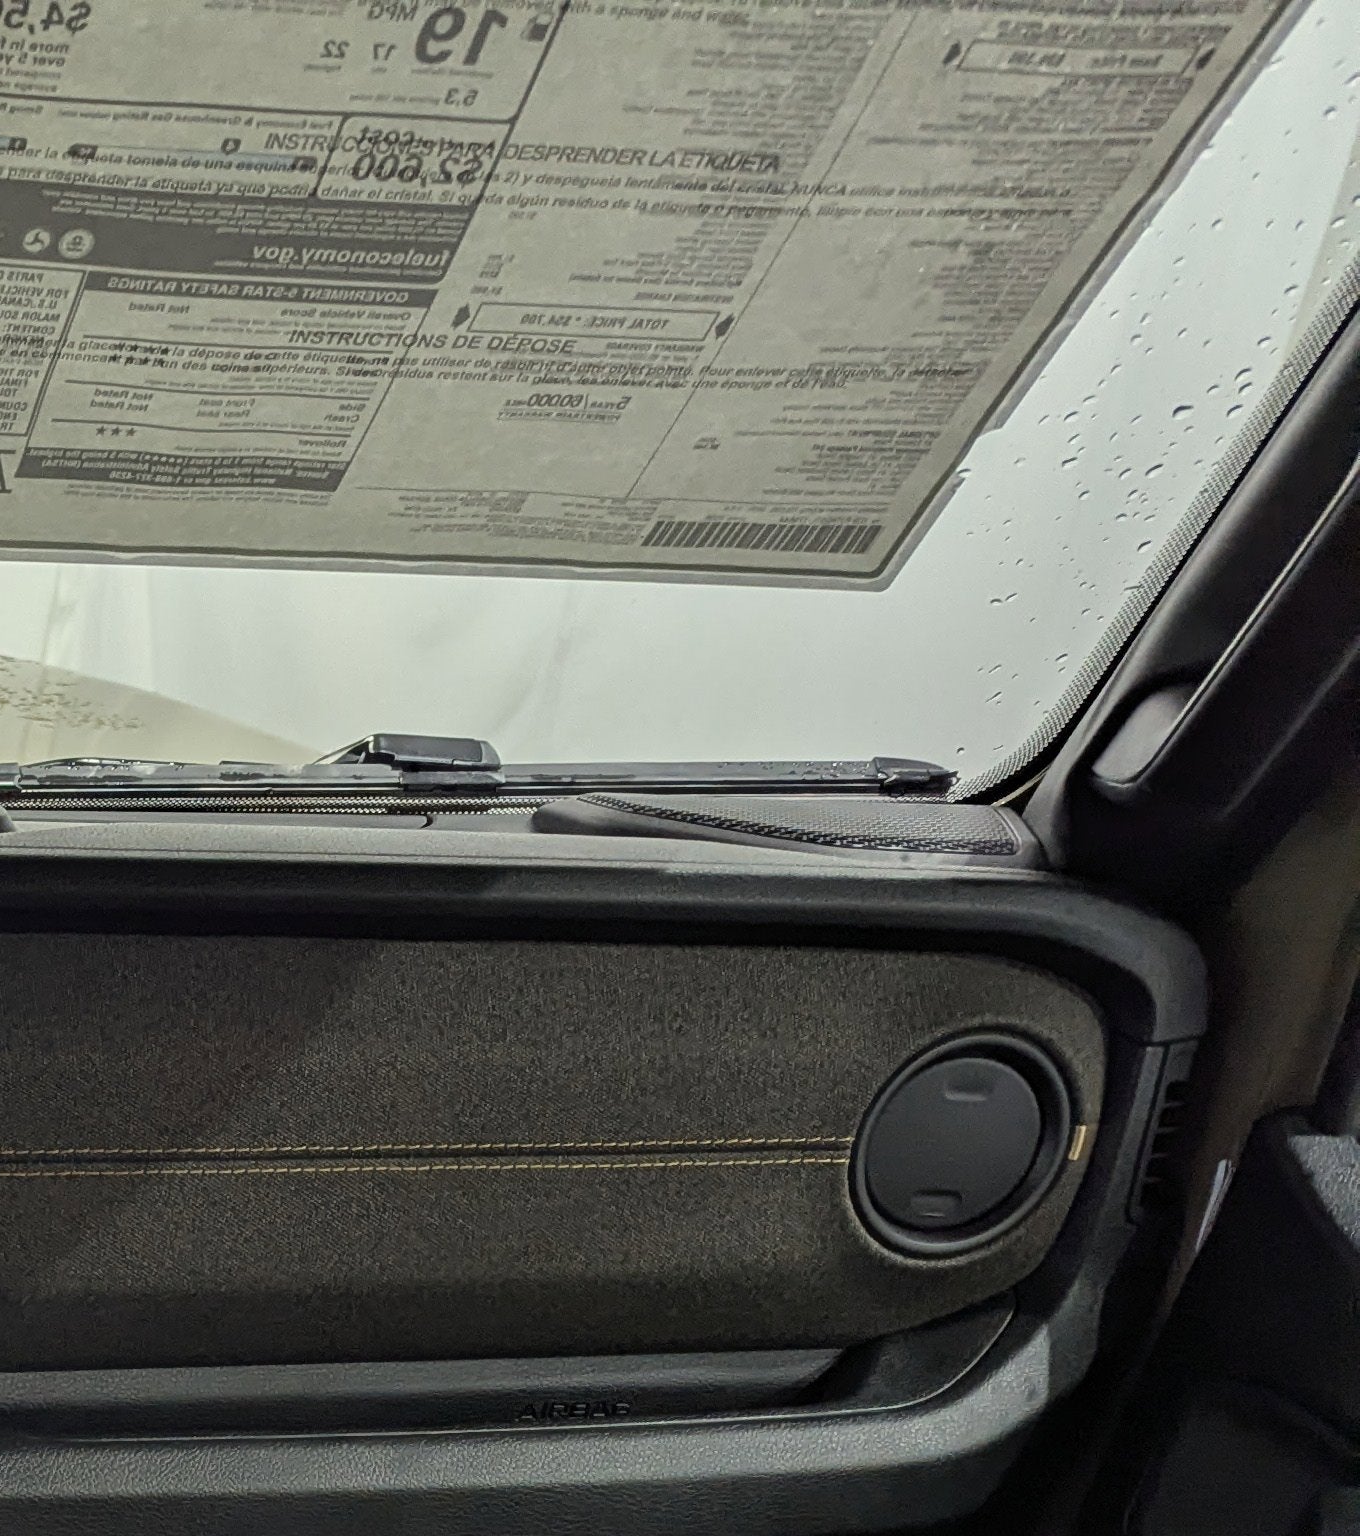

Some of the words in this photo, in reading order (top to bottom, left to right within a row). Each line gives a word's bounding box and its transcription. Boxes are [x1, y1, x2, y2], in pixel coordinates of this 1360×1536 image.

[501, 143, 644, 167] DESPRENDER
[648, 150, 675, 168] LA
[677, 151, 782, 173] ETIQUETA
[287, 330, 451, 349] INSTRUCTIONS
[456, 335, 482, 350] DE
[487, 332, 576, 353] DÉPOSE
